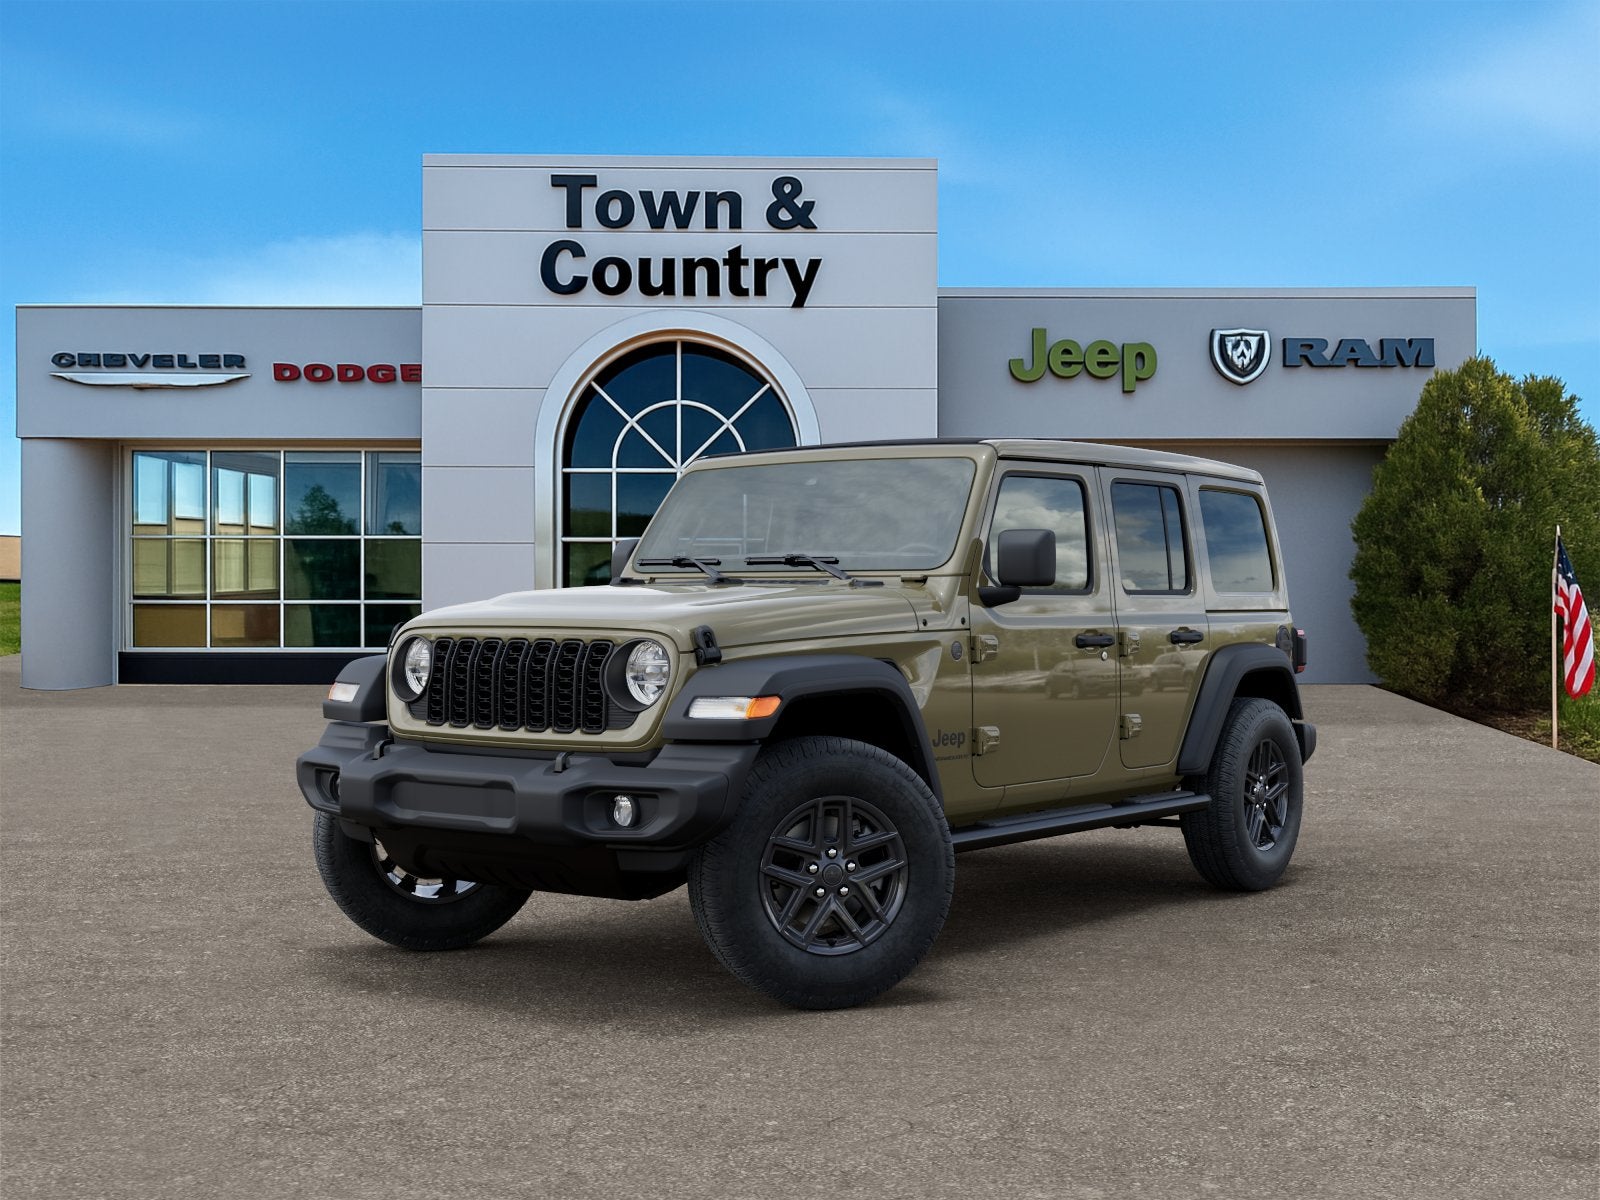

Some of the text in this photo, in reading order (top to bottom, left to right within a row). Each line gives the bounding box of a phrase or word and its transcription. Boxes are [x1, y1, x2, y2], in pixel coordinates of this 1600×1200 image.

[550, 174, 818, 230] Town &
[539, 239, 823, 308] Country
[272, 362, 422, 384] DODGE
[1008, 327, 1158, 393] Jeep
[1282, 337, 1436, 368] RAM
[932, 728, 966, 749] Jeep
